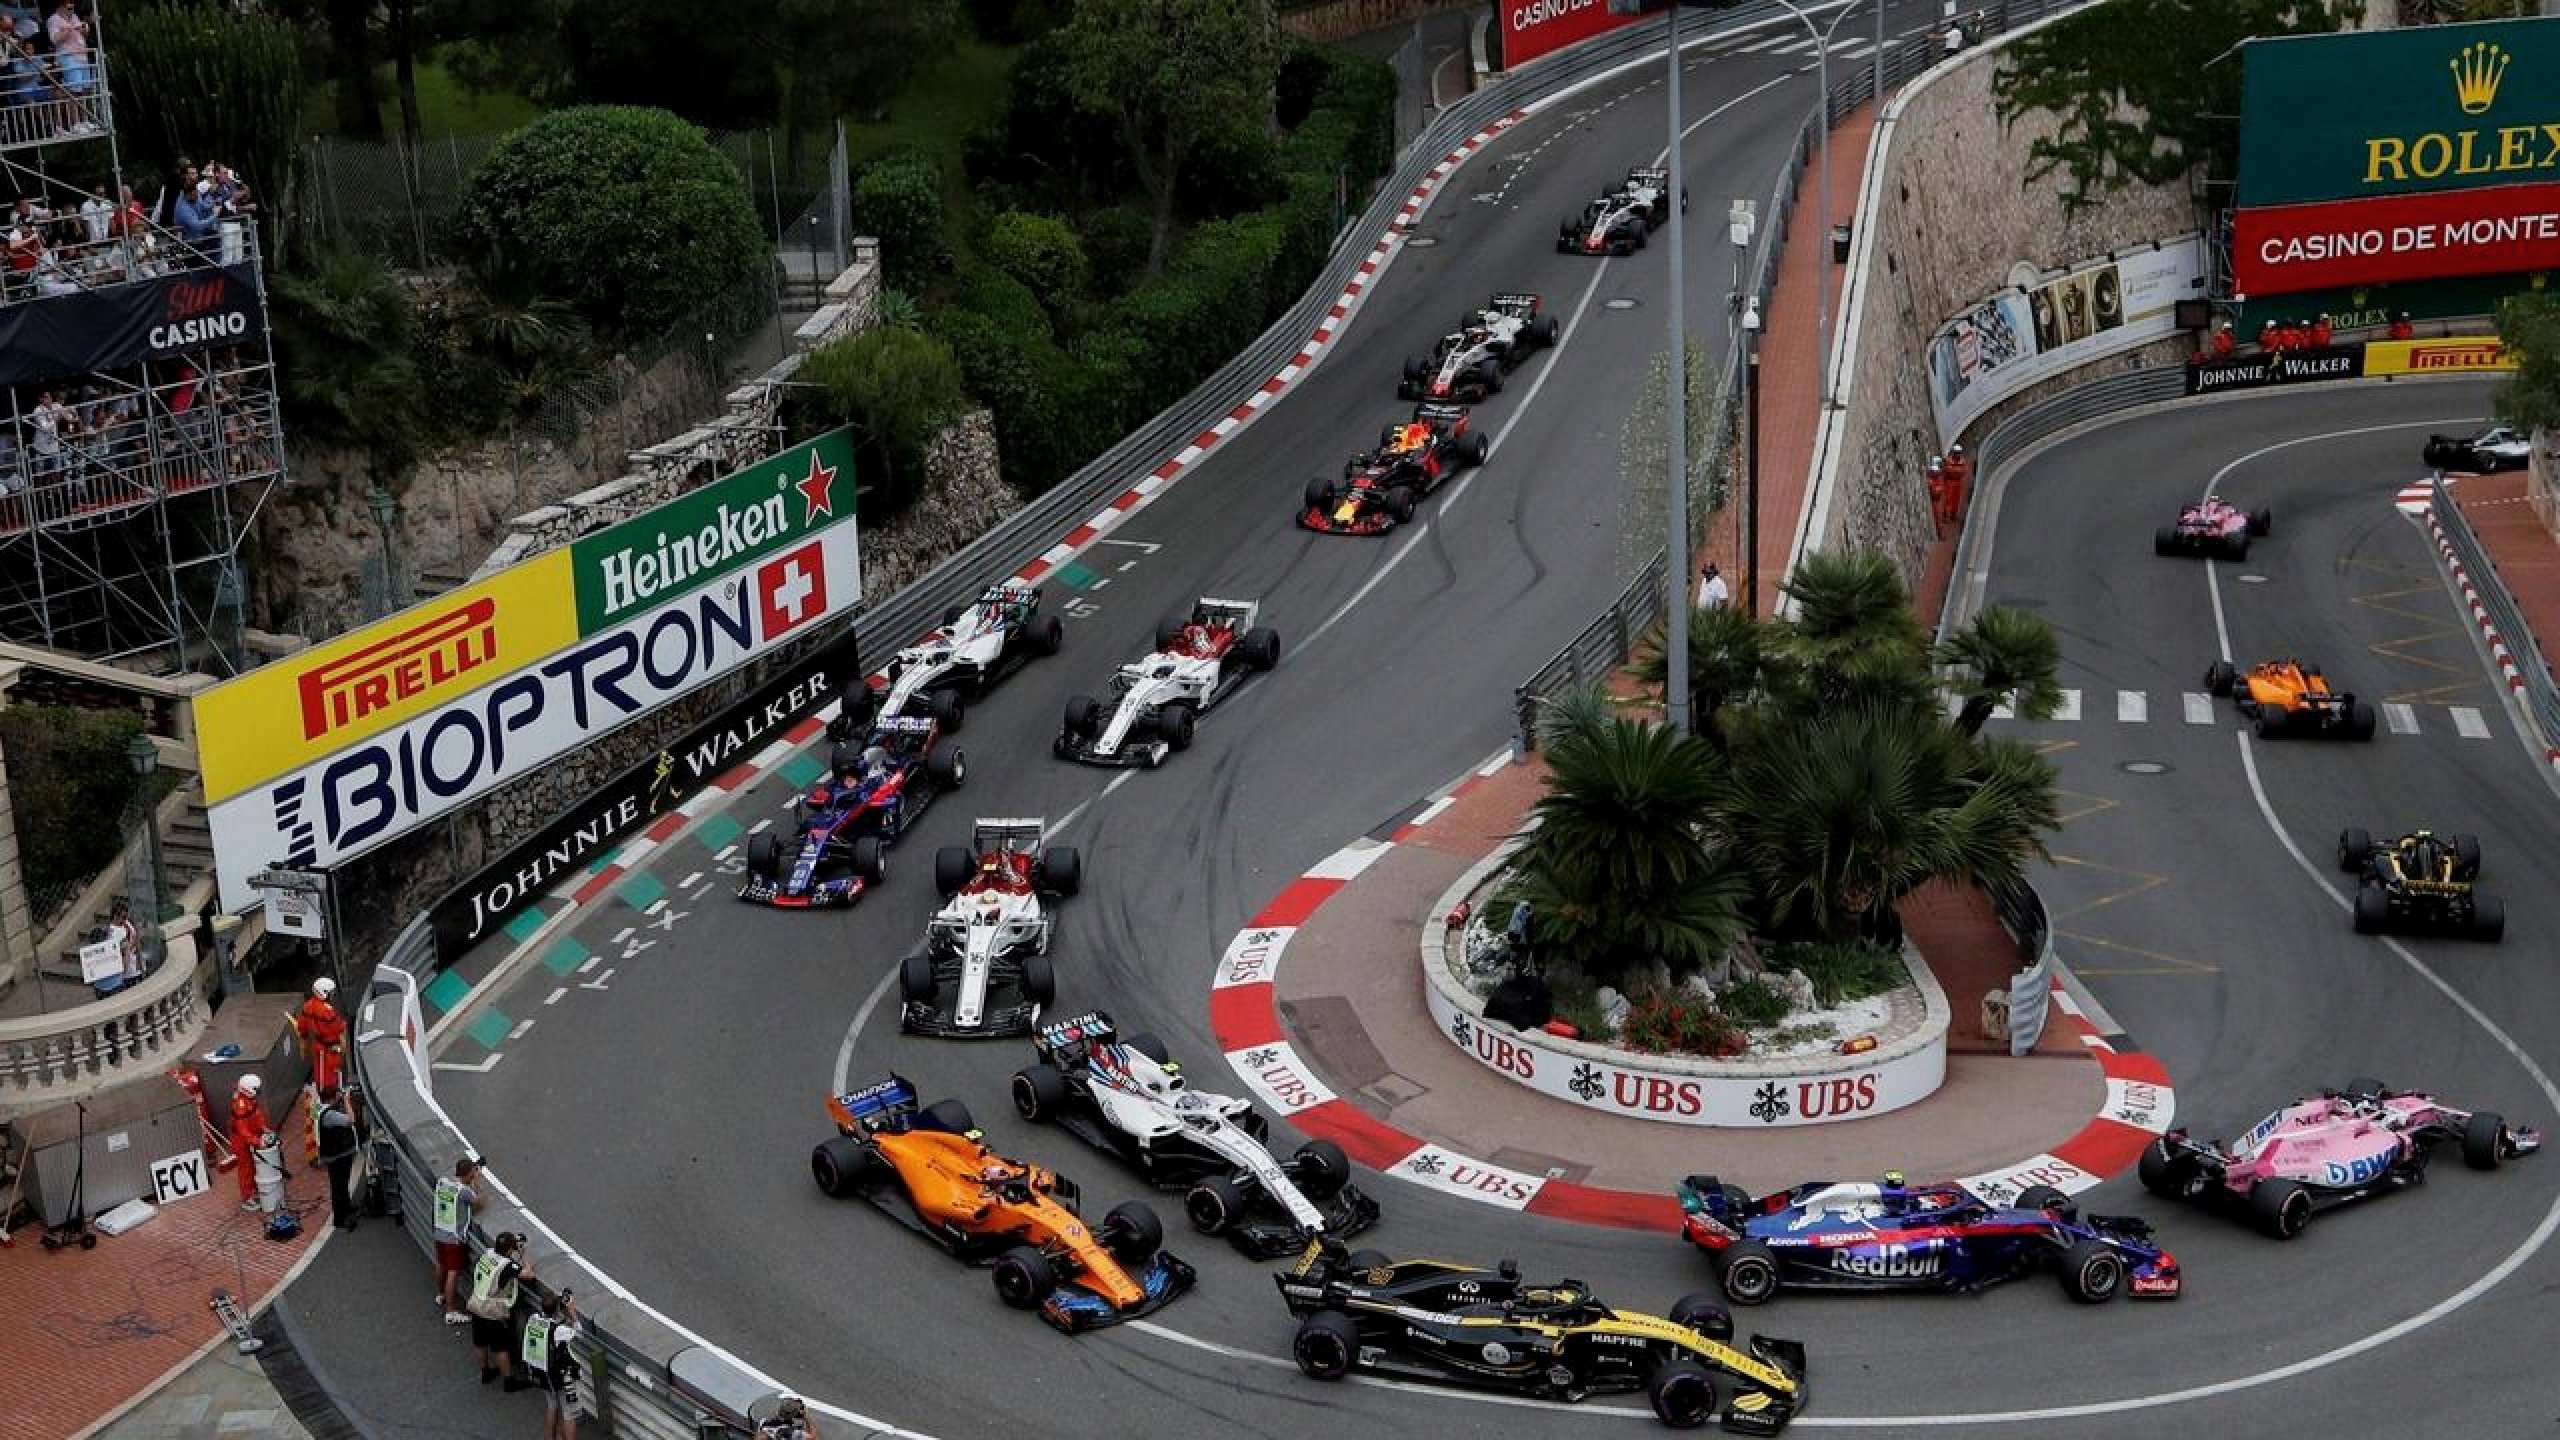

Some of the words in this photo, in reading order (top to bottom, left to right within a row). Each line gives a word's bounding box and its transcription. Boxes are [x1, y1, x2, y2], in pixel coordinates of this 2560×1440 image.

[2261, 229, 2384, 264] CASINO
[2392, 224, 2437, 253] DE
[2444, 213, 2559, 247] MONTE
[149, 311, 246, 349] CASINO
[2196, 365, 2265, 391] JOHNNIE
[2285, 357, 2350, 376] WALKER
[600, 492, 789, 616] Heineken
[297, 597, 496, 742] PIRELLI
[321, 575, 752, 852] BIOPTRON
[467, 794, 639, 940] JOHNNIE
[684, 671, 832, 778] WALKER
[1229, 946, 1269, 983] UBS
[1475, 1028, 1535, 1080] UBS
[1261, 1065, 1318, 1107] UBS
[1612, 1071, 1702, 1116] UBS
[1797, 1073, 1876, 1119] UBS
[155, 1158, 199, 1201] FCY
[1450, 1164, 1533, 1202] UBS
